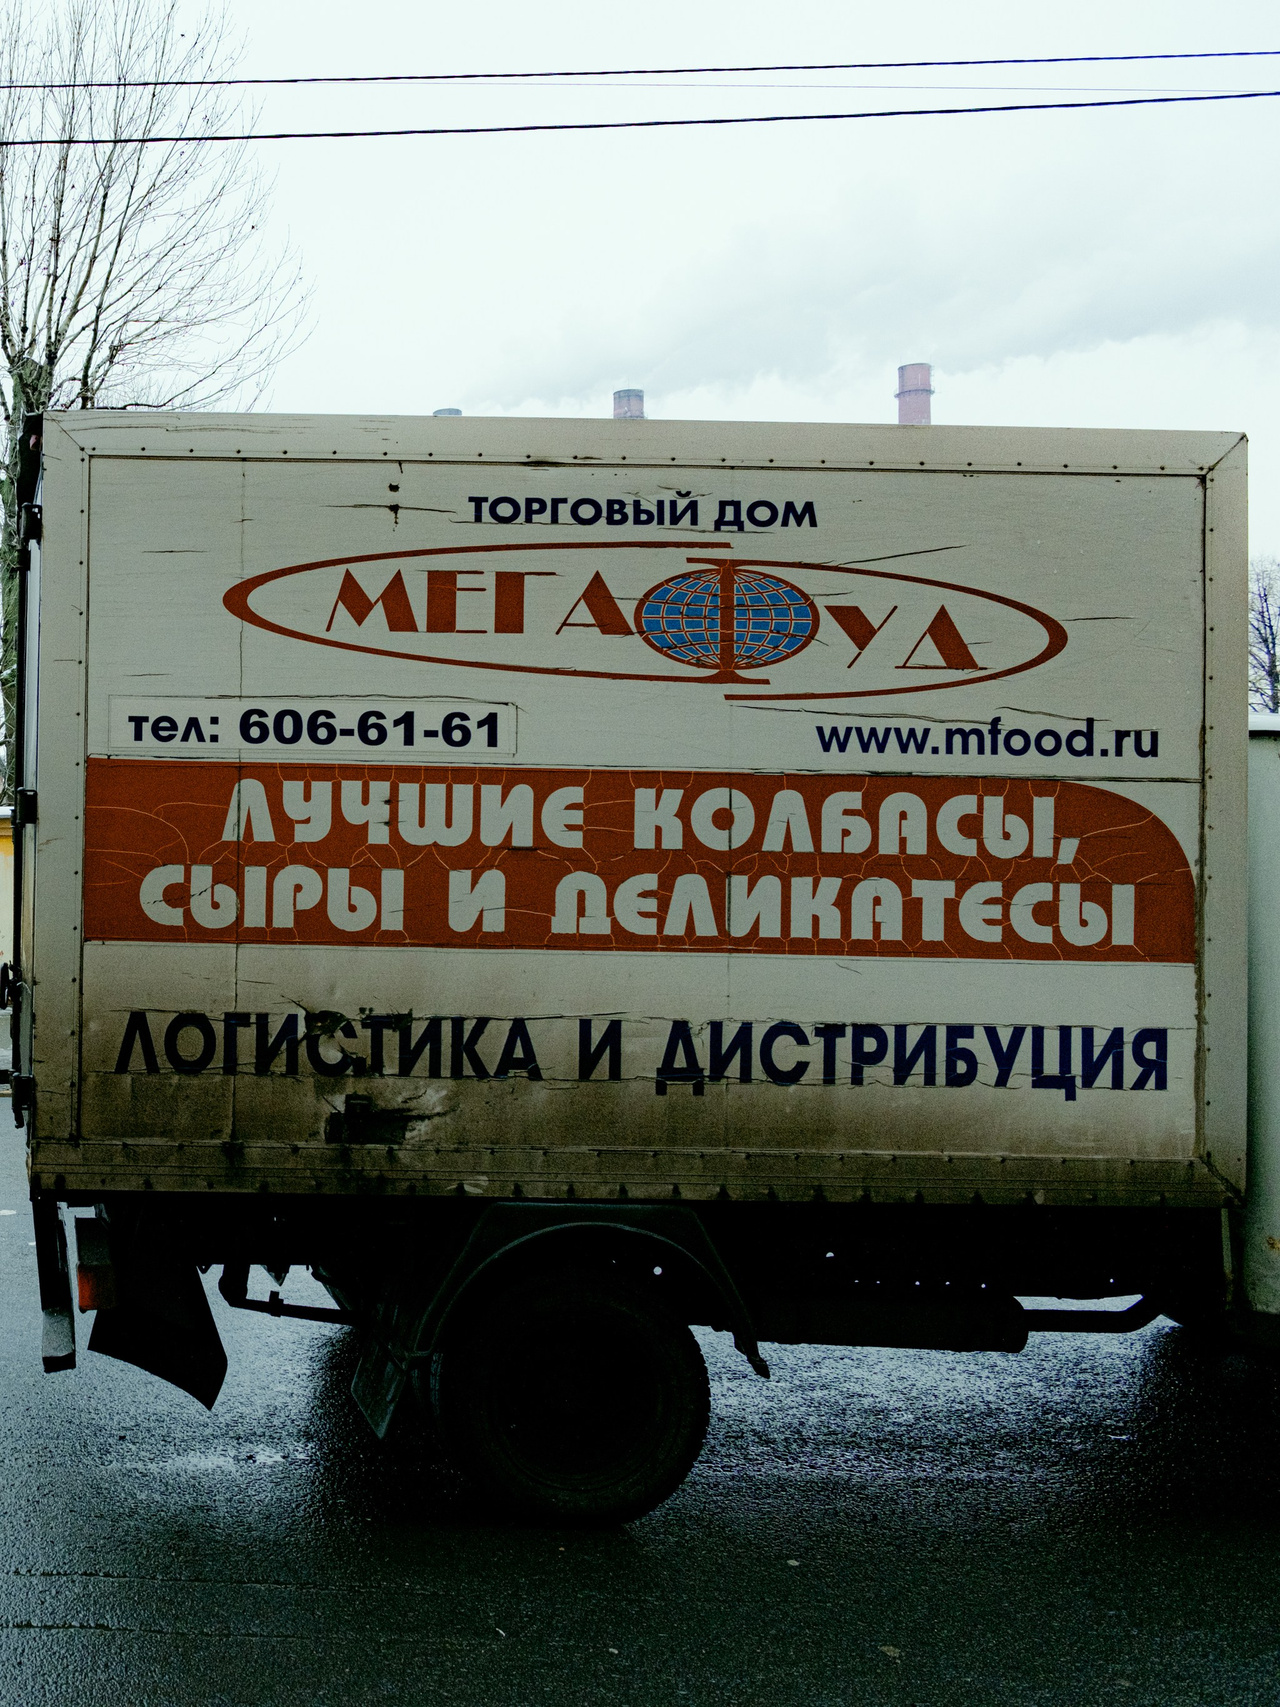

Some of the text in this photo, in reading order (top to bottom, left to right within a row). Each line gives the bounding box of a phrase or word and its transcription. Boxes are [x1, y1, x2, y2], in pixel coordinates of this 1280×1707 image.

[467, 491, 819, 532] ТОРГОВЫЙ ДОМ
[128, 708, 500, 749] тел: 606-61-61
[815, 717, 1160, 759] www.mfood.ru
[221, 778, 1082, 865] ЛУЧШИЕ КОЛБАСЫ,
[138, 863, 1136, 947] СЫРЫ И ДЕЛИКАТЕСЫ
[114, 1010, 1169, 1101] ЛОГИСТИКА И ДИСТРИБУЦИЯ
